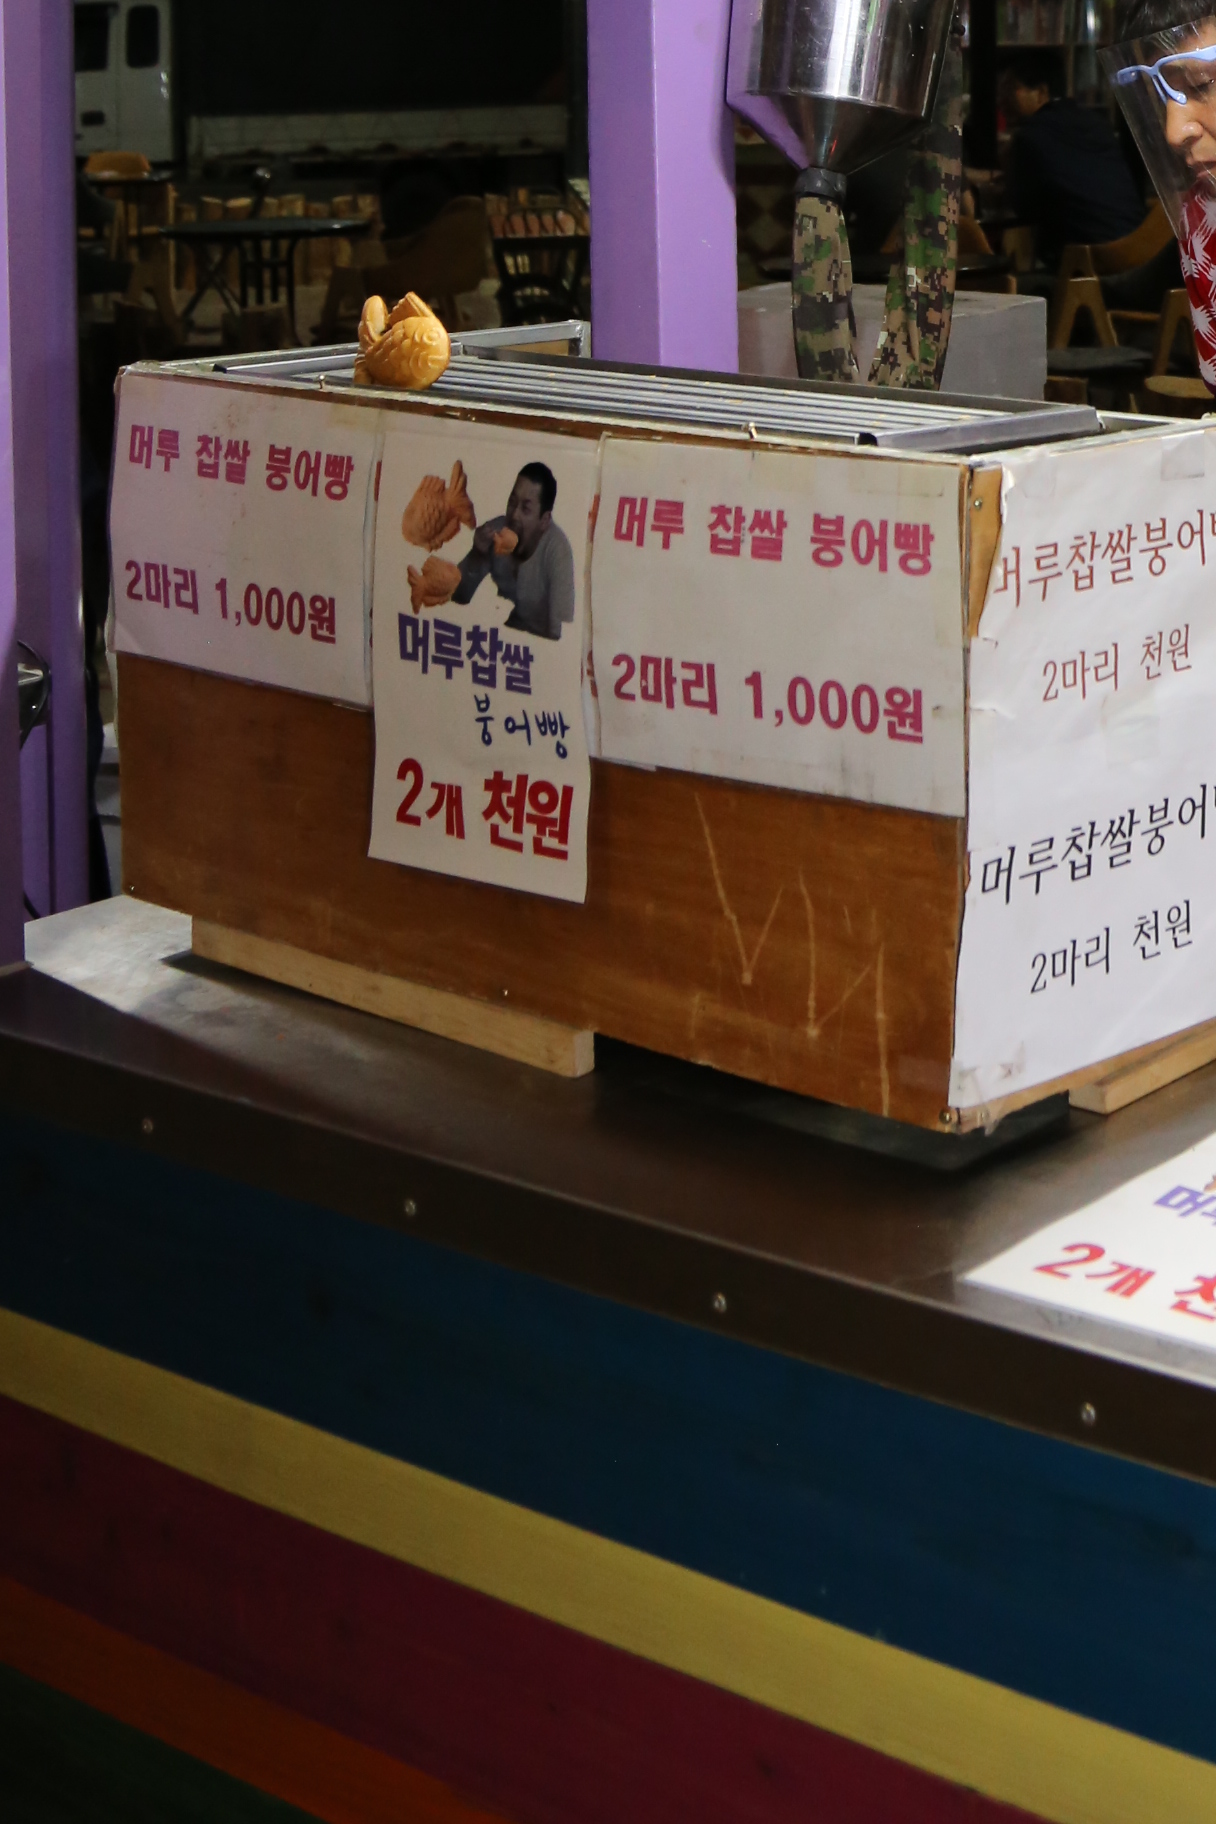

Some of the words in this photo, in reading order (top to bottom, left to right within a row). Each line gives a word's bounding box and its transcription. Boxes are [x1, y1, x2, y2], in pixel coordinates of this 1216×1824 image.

[129, 424, 181, 472] 머루
[195, 433, 251, 485] 찹쌀
[265, 443, 354, 502] 붕어빵
[612, 495, 685, 551] 머루
[706, 502, 787, 563] 찹쌀
[809, 513, 935, 577] 붕어빵
[124, 560, 199, 615] 2마리
[214, 577, 337, 645] 1,000원
[397, 612, 534, 695] 머루찹쌀
[1042, 641, 1121, 703] 2마리
[1139, 622, 1192, 681] 천원
[473, 694, 570, 759] 붕어빵
[611, 651, 719, 717] 2마리
[743, 669, 924, 745] 1,000원
[395, 757, 465, 840] 2개
[481, 769, 574, 861] 천원
[1029, 926, 1112, 995] 2마리
[1131, 898, 1194, 961] 천원
[1032, 1242, 1157, 1299] 2개
